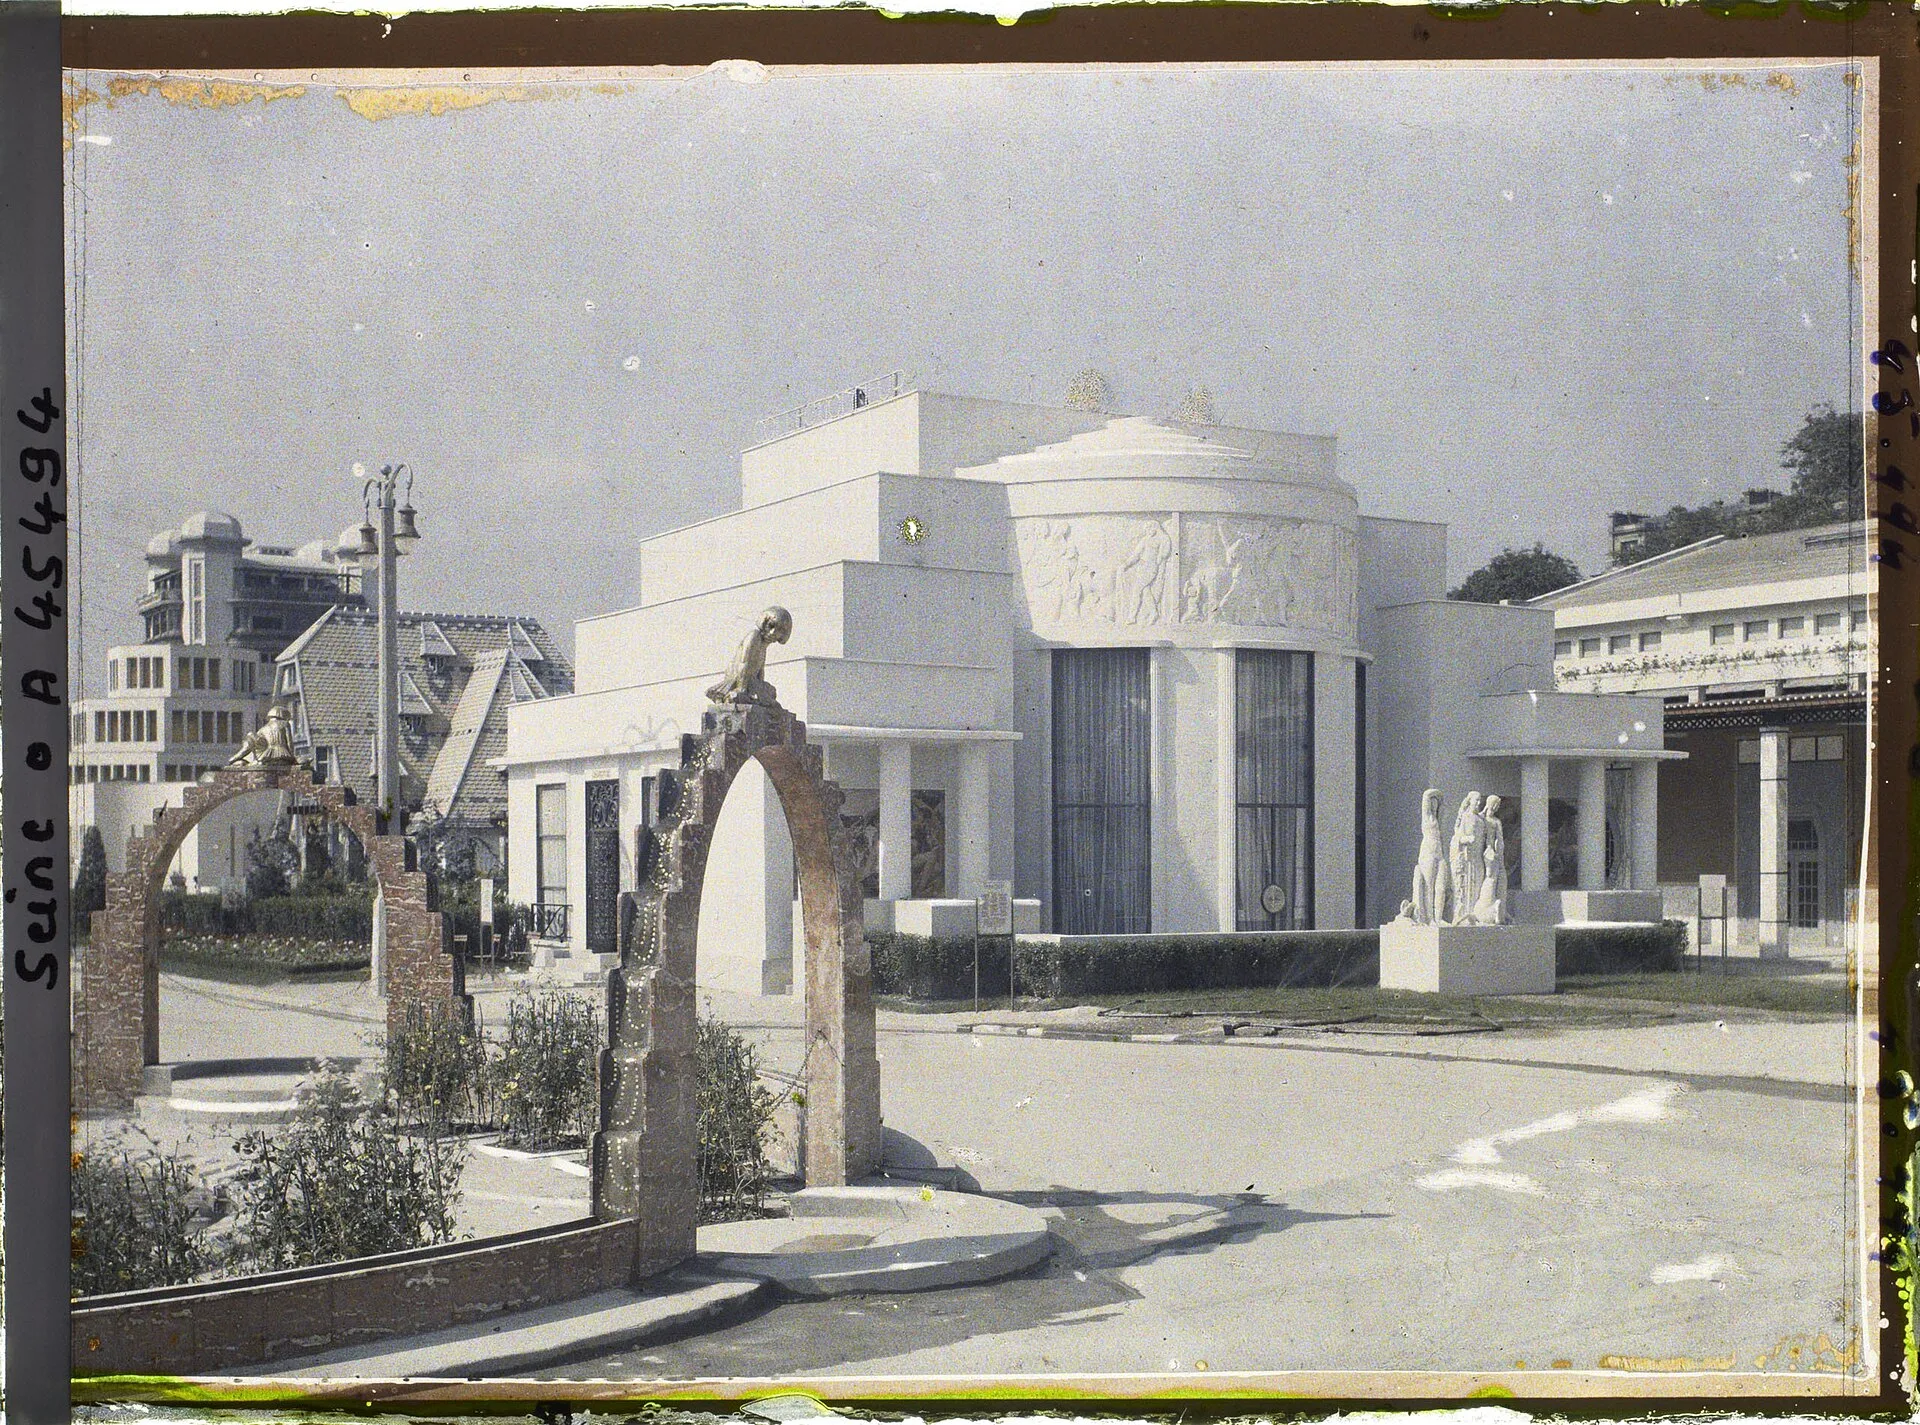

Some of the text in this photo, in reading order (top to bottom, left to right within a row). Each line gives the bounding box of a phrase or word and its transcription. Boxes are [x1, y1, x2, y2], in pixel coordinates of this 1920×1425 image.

[14, 387, 65, 630] 45494
[21, 669, 61, 705] A
[5, 819, 58, 990] Seine
